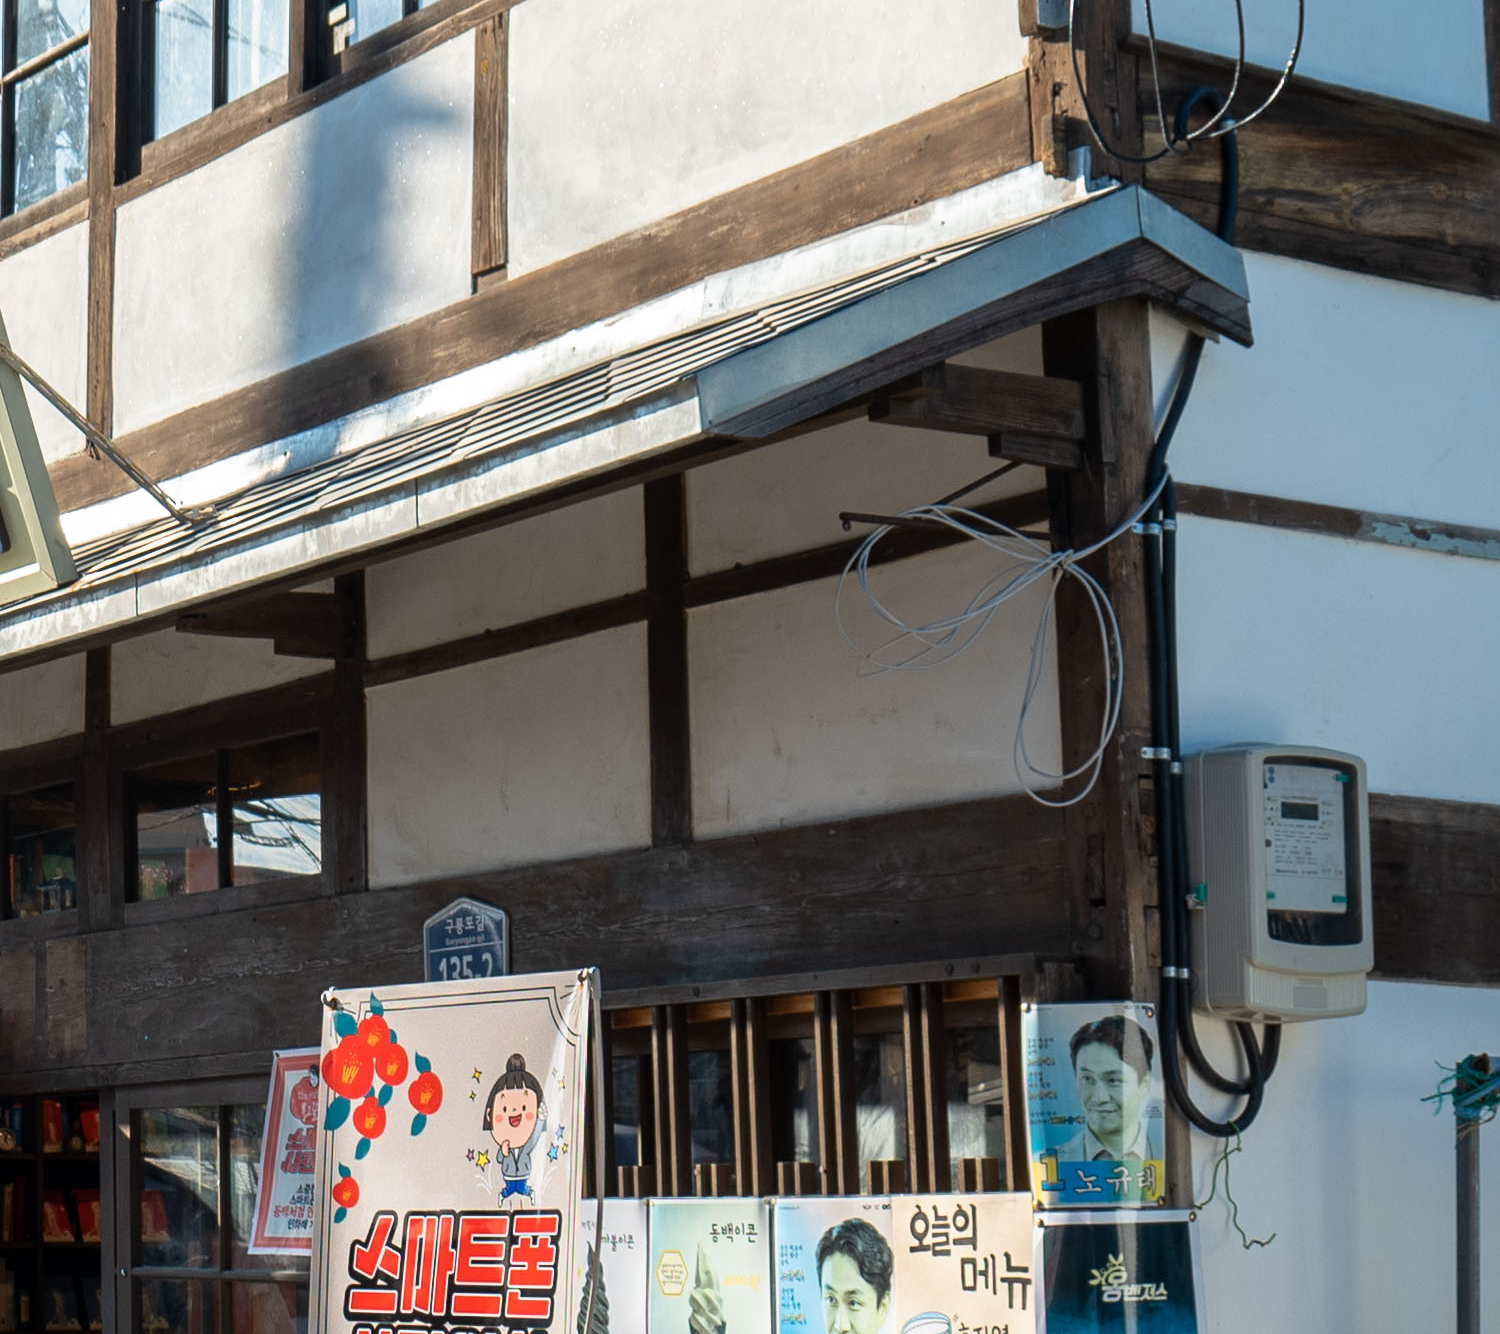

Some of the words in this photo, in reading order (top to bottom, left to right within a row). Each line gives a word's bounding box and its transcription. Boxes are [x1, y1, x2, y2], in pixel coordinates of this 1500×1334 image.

[444, 914, 485, 936] 구룡포길
[1040, 1148, 1066, 1192] 1
[1075, 1163, 1156, 1198] 노규태
[709, 1223, 759, 1244] 동백이콘
[909, 1203, 978, 1257] 오늘의
[347, 1212, 560, 1322] 스마트폰
[960, 1251, 1032, 1311] 메뉴
